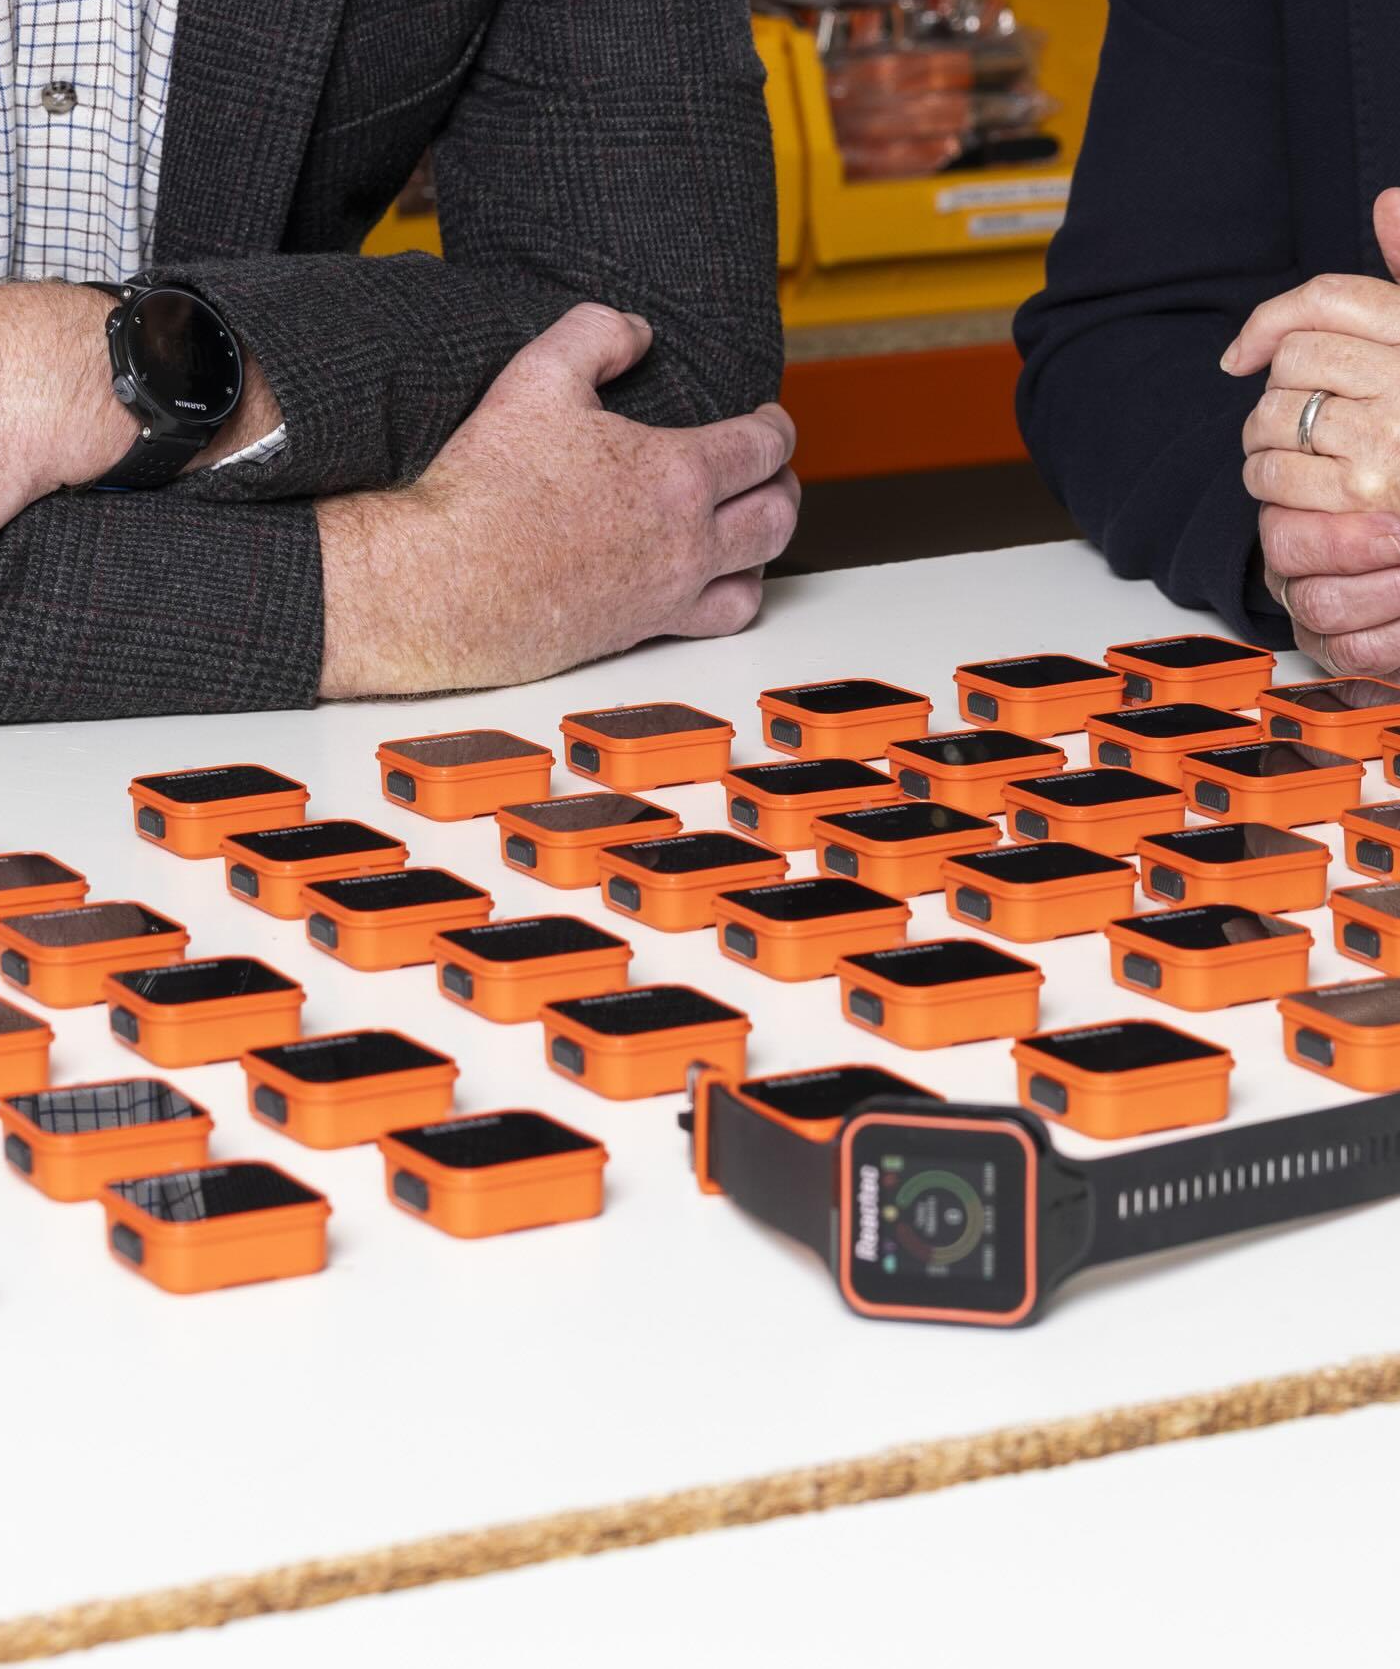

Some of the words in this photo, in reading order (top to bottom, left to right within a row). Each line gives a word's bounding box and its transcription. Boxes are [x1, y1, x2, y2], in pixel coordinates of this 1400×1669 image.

[175, 399, 207, 411] GARMIN
[1134, 639, 1187, 649] Reactec
[985, 658, 1040, 669] Reactec
[790, 683, 847, 694] Reactec
[594, 708, 653, 718] Reactec
[1117, 706, 1174, 717] Reactec
[411, 735, 471, 745] Reactec
[919, 733, 977, 744] Reactec
[1213, 745, 1270, 755] Reactec
[759, 761, 822, 771] Reactec
[166, 769, 228, 780] Reactec
[1035, 772, 1096, 784] Reactec
[532, 797, 595, 809] Reactec
[847, 806, 908, 818] Reactec
[258, 825, 324, 837] Reactec
[1172, 826, 1234, 838] Reactec
[632, 837, 696, 849] Reactec
[976, 846, 1039, 859] Reactec
[339, 873, 407, 886] Reactec
[750, 882, 816, 896] Reactec
